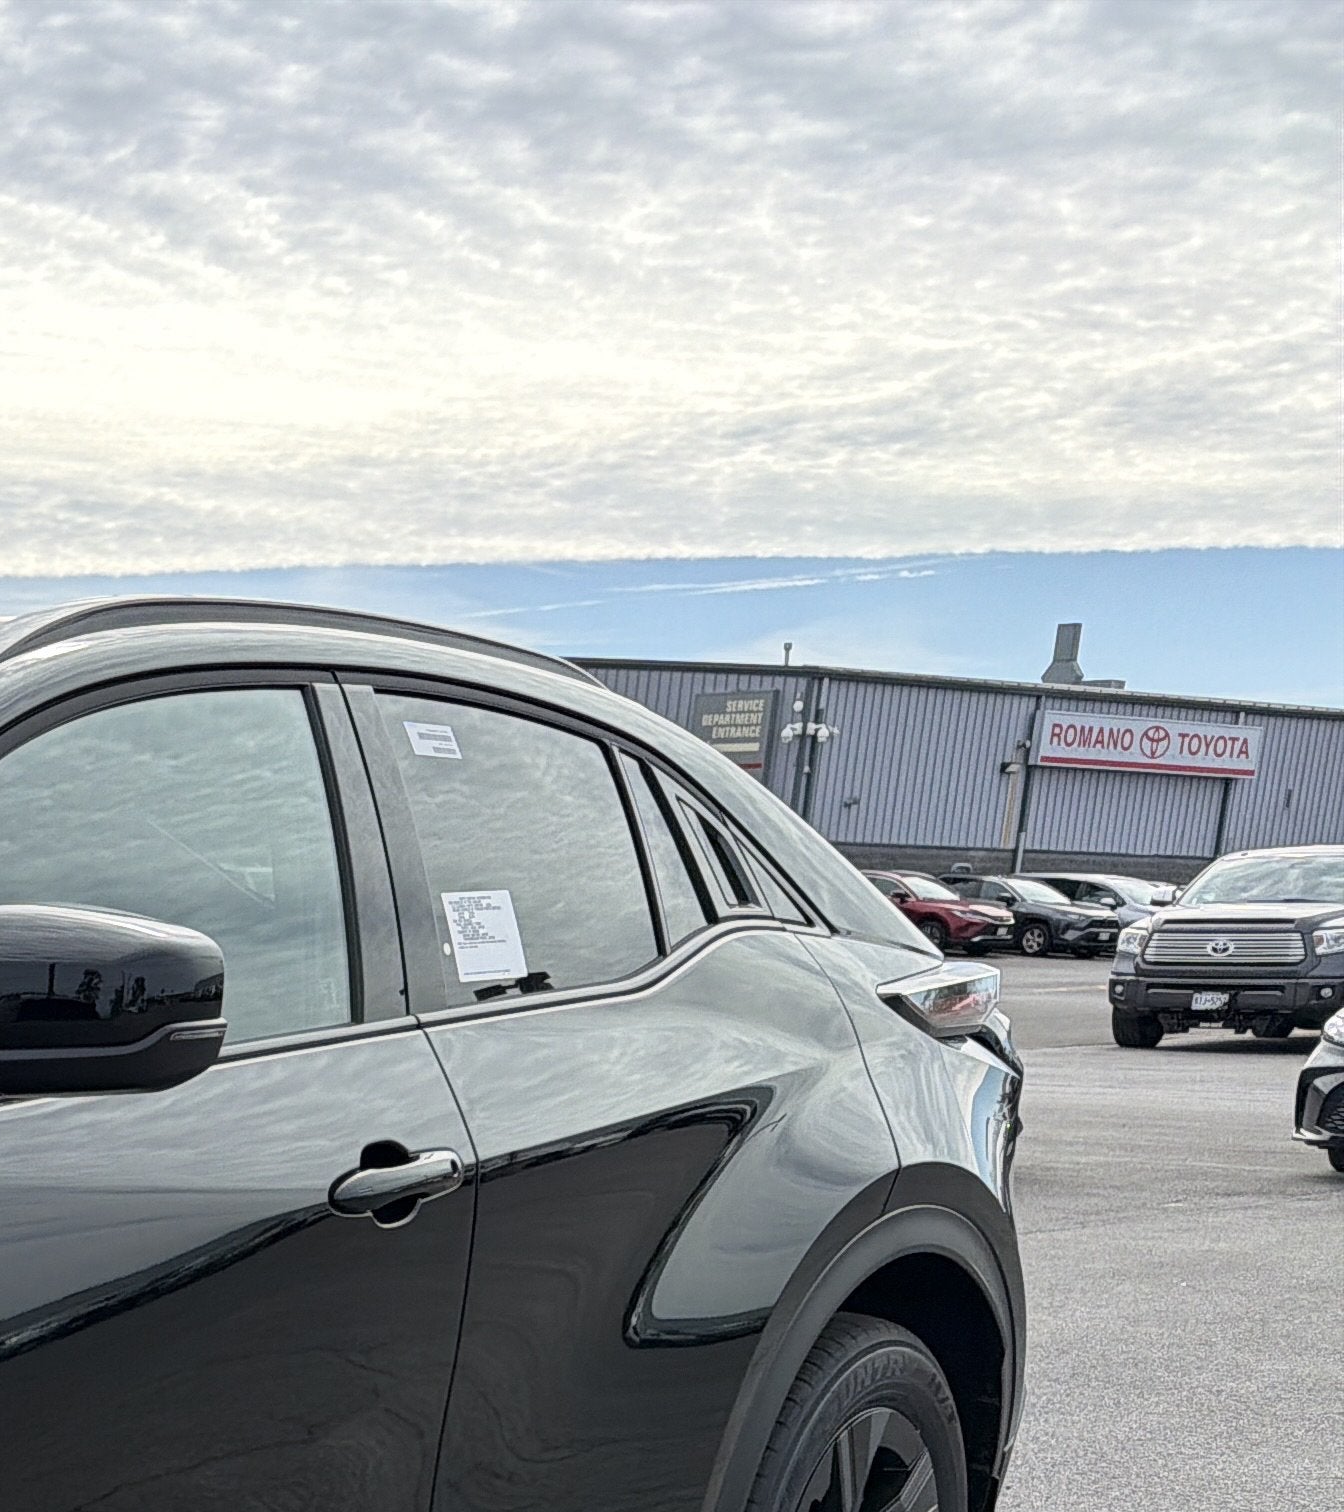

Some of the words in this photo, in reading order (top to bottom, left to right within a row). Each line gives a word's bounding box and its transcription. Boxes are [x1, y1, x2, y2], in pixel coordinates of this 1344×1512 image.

[726, 700, 764, 712] SERVICE
[702, 712, 763, 726] DEPARTMENT
[712, 725, 761, 738] ENTRANCE
[1049, 723, 1134, 751] ROMANO
[1178, 732, 1250, 759] TOYOTA
